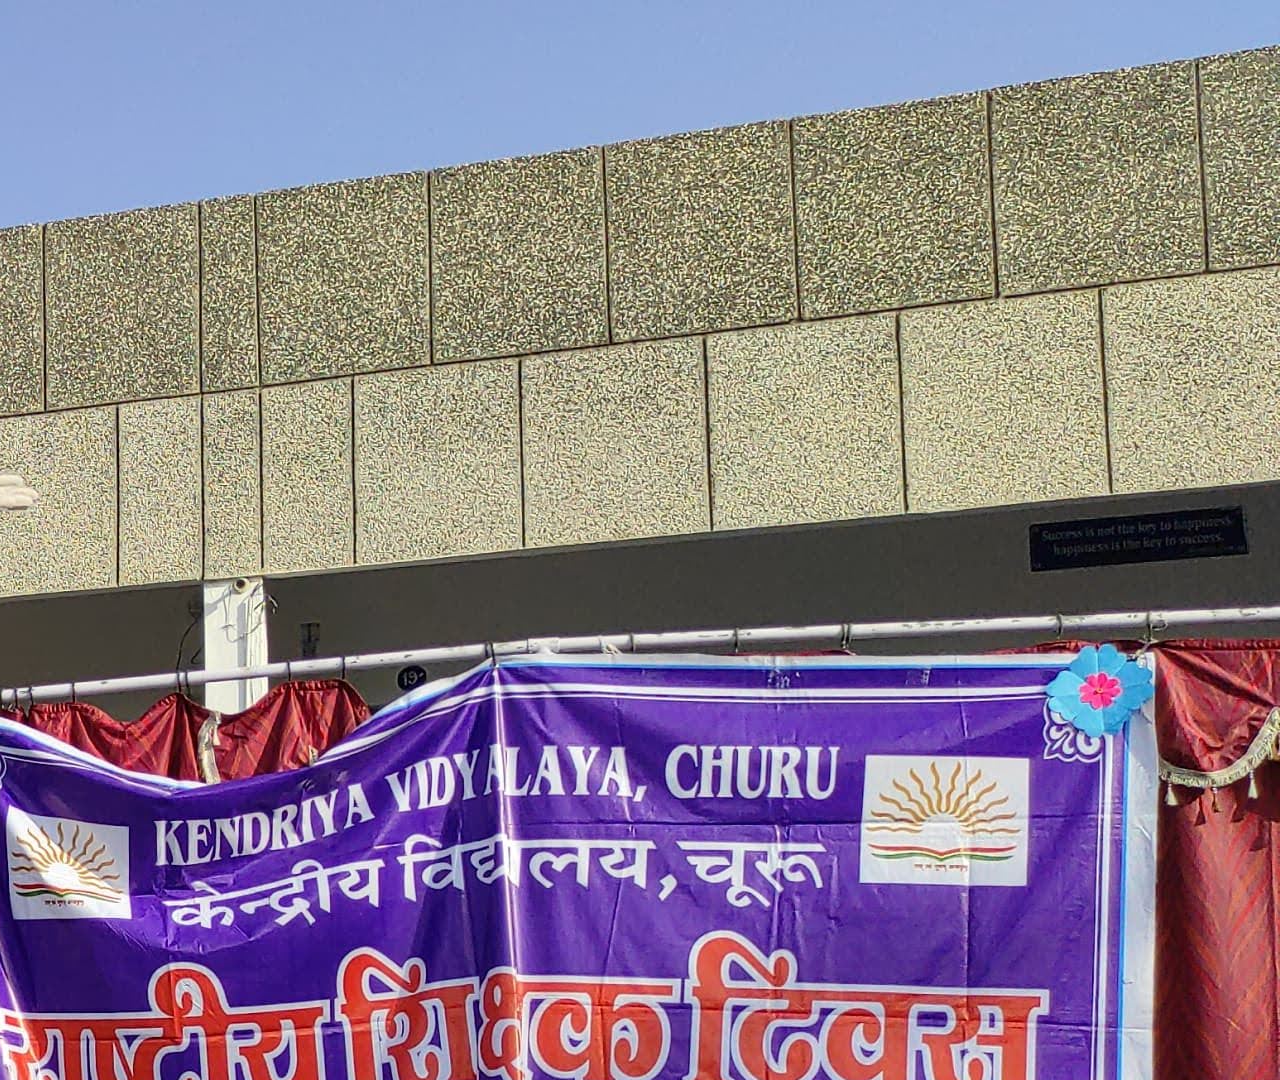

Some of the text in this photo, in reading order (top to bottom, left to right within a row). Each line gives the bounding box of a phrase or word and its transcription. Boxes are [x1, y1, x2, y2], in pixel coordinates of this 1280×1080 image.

[154, 743, 839, 867] KENDRIYA VIDYALAYA, CHURU
[162, 859, 386, 929] केन्द्रीय
